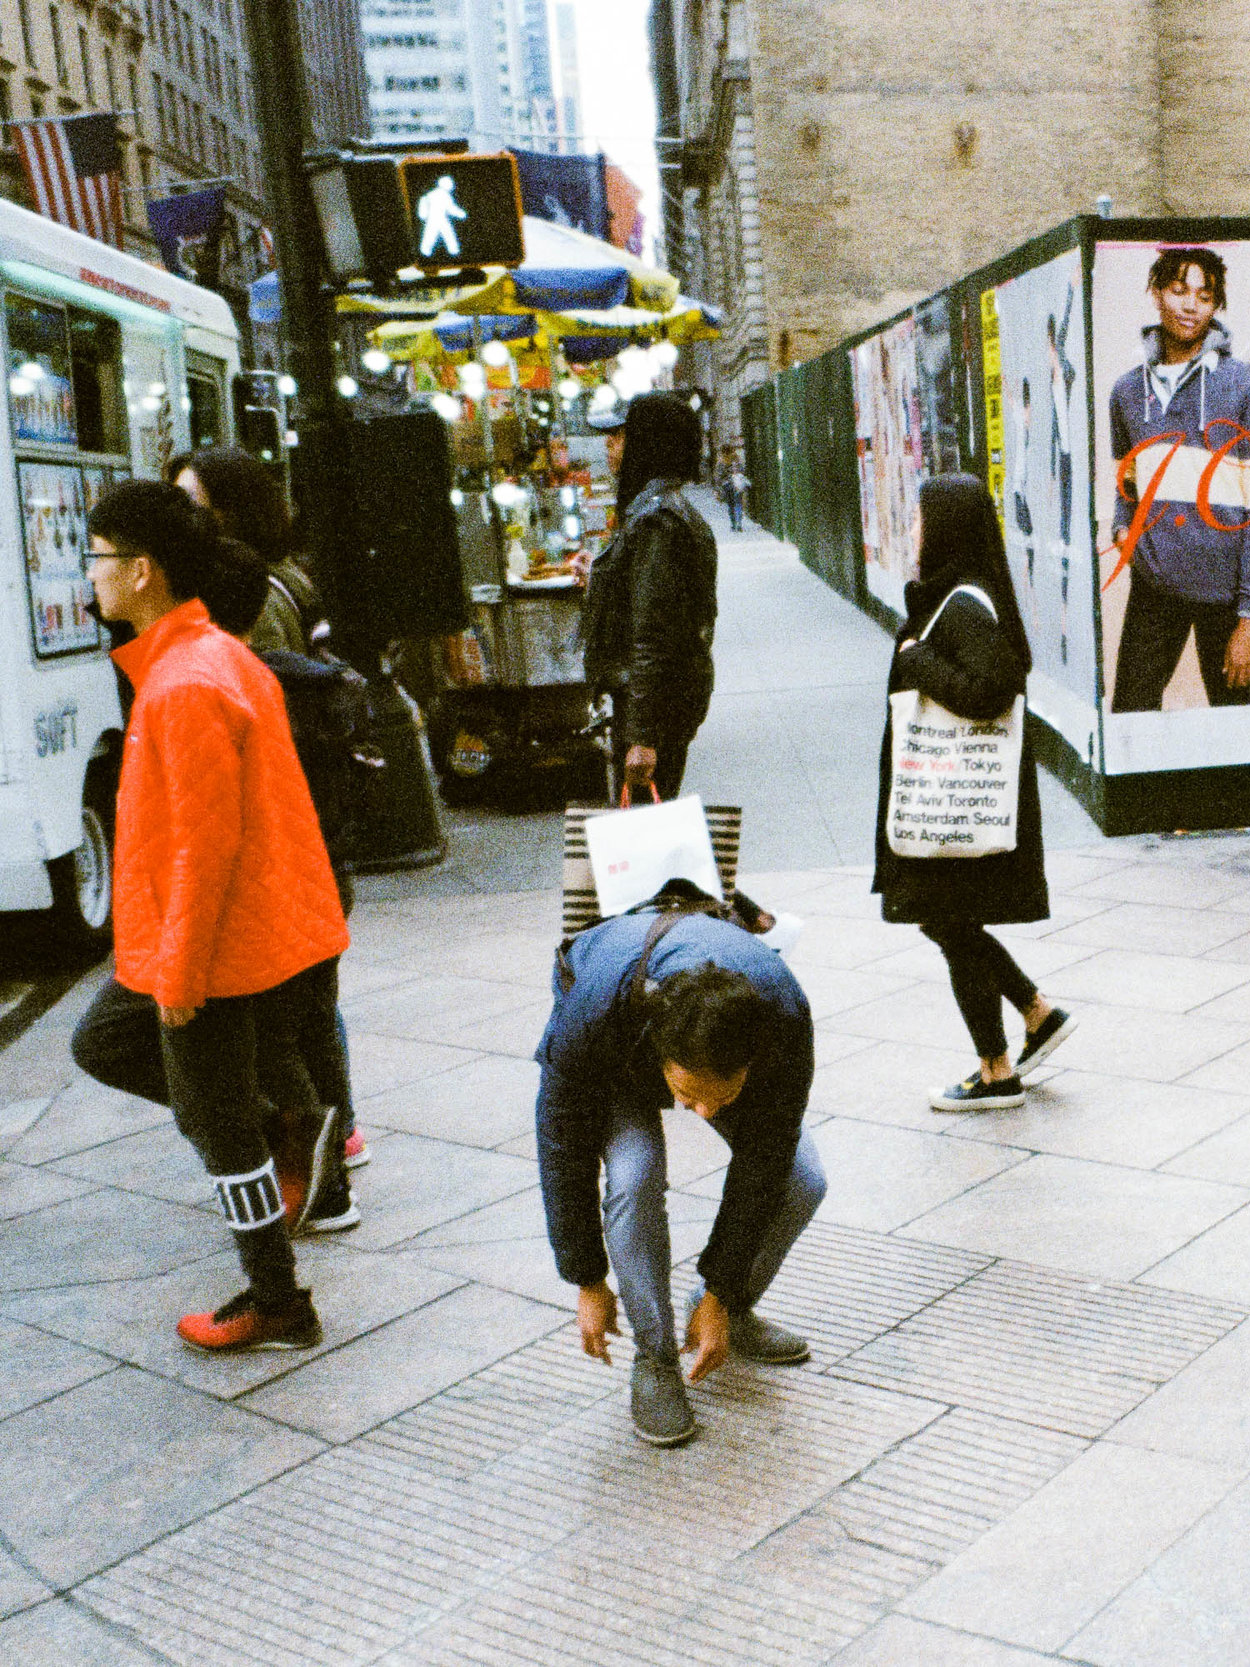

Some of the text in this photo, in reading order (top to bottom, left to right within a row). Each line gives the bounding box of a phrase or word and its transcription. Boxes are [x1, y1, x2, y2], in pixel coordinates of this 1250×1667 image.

[955, 741, 998, 755] Vienna
[962, 757, 1003, 774] Tokyo
[938, 775, 1006, 790] Vancouver
[917, 792, 945, 808] Aviv
[948, 794, 998, 808] Toronto
[893, 810, 1010, 827] Amsterdam Seoul
[919, 829, 975, 846] Angeles
